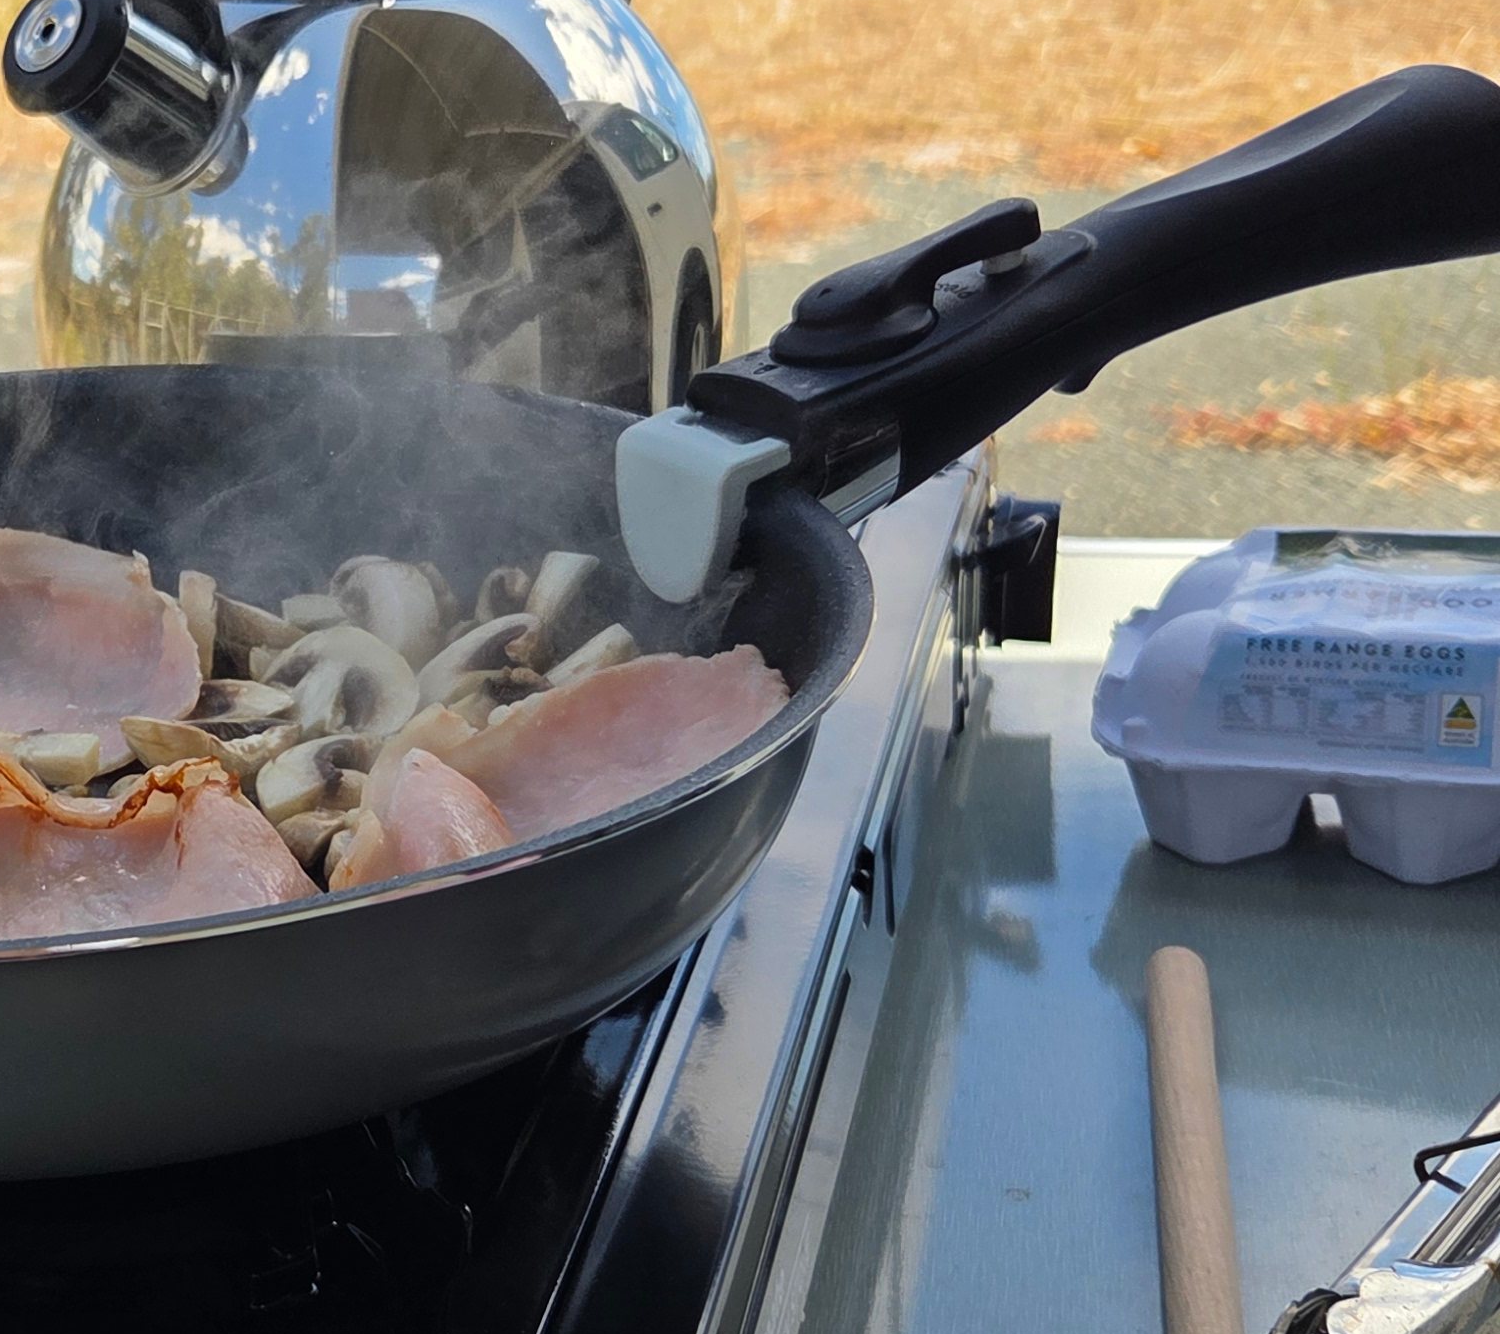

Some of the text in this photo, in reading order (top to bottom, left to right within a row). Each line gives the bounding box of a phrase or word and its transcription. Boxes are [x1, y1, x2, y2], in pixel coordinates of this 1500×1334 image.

[1246, 636, 1466, 661] FREE RANGE EGGS
